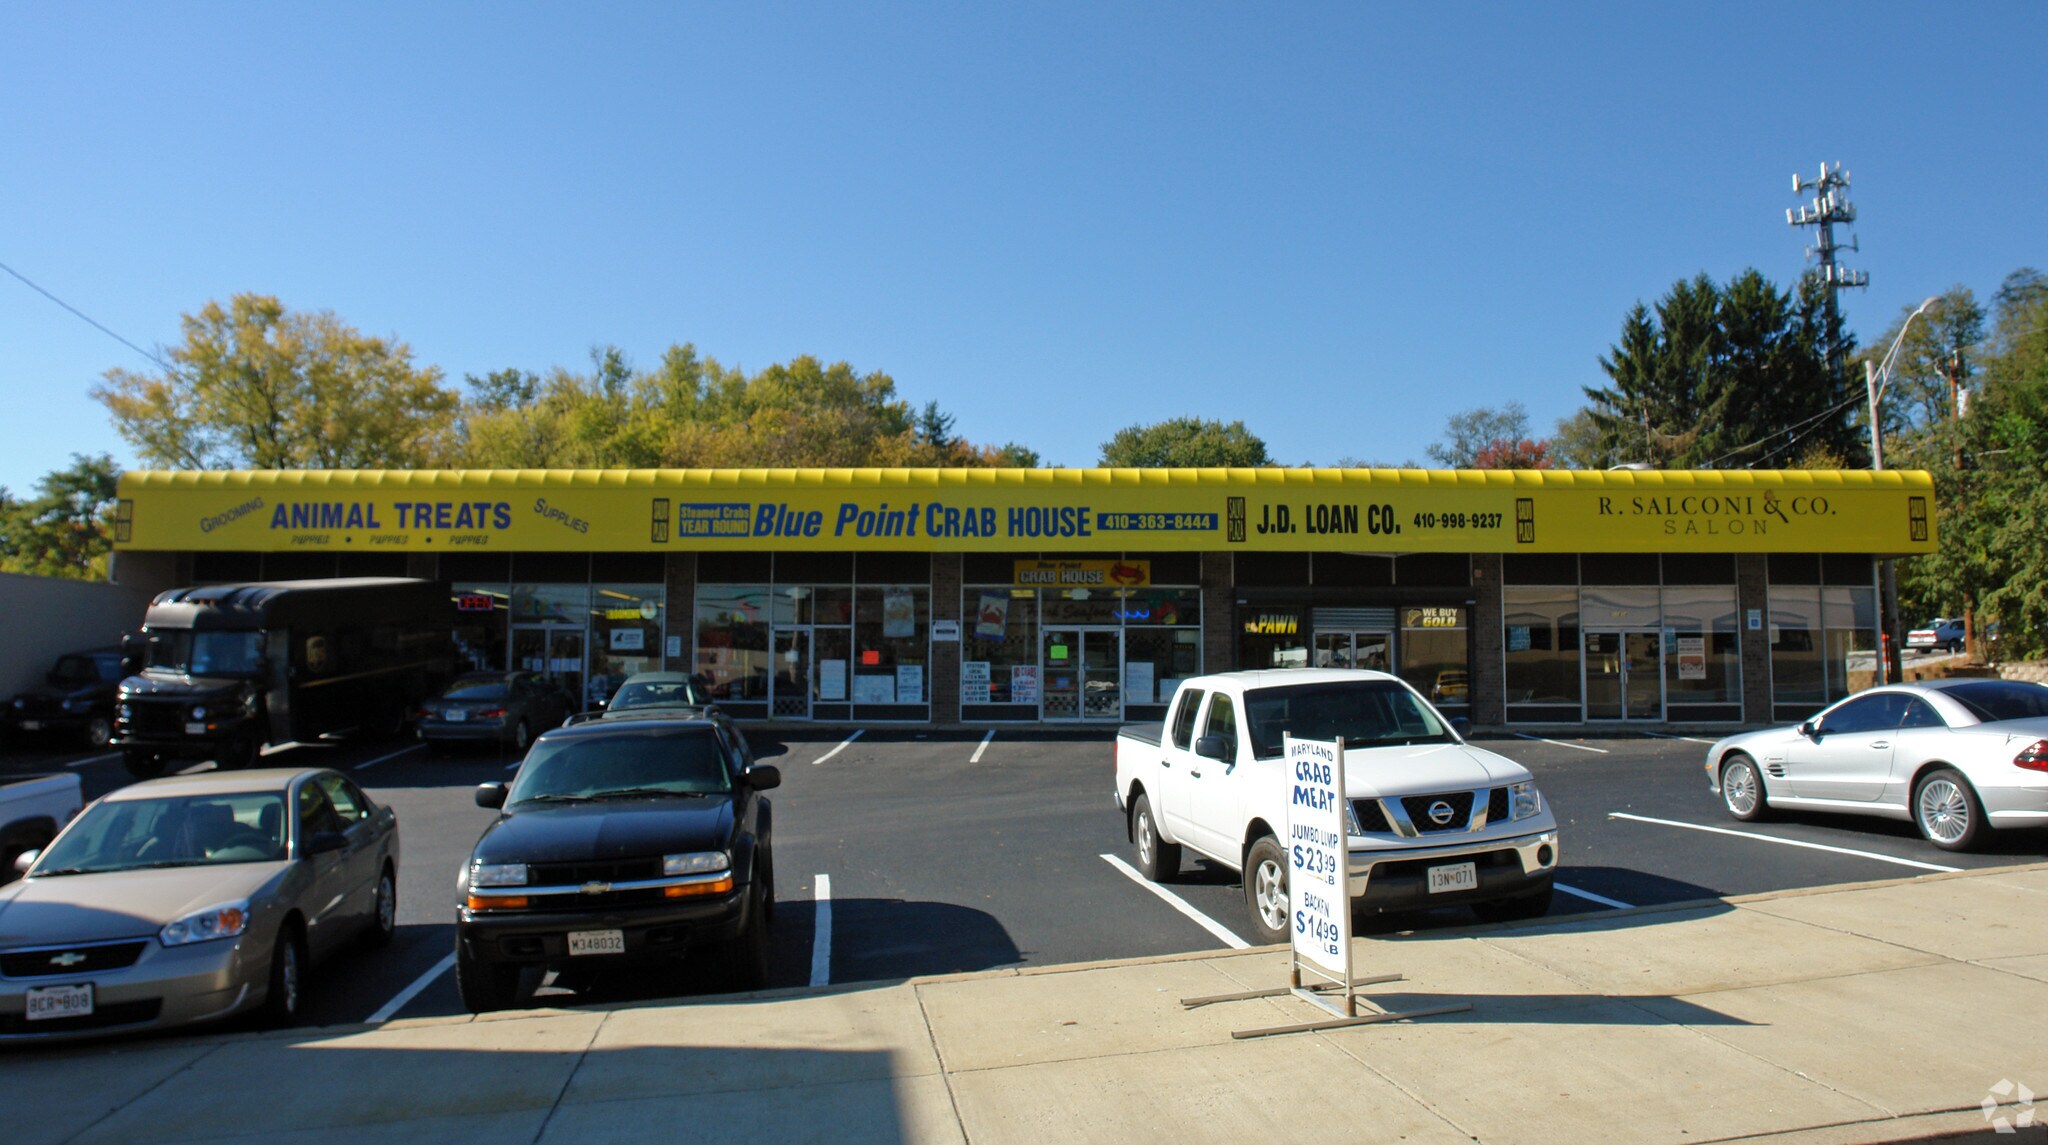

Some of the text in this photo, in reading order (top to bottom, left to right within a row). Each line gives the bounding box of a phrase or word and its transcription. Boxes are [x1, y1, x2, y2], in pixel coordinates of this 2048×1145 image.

[200, 496, 264, 534] GROOMING
[270, 502, 512, 530] ANIMAL TREATS
[533, 498, 589, 534] SUPPLIES
[681, 506, 750, 519] Steamed Crabs
[1598, 493, 1837, 523] R. SALCONI & CO.
[681, 519, 748, 534] YEAR ROUND
[753, 502, 1092, 537] Blue Point CRAB HOUSE
[1105, 515, 1211, 529] 410-363-8444
[1256, 504, 1401, 535] J.D. LOAN CO.
[1413, 513, 1502, 529] 410-998-9237
[1664, 519, 1768, 535] SALON
[1020, 570, 1104, 583] CRAB HOUSE
[460, 596, 491, 609] OPEN
[1423, 608, 1458, 617] WE BUY
[1258, 614, 1298, 634] PAWN
[1423, 616, 1457, 627] GOLD
[1291, 744, 1334, 762] MARYLAND
[1296, 761, 1332, 786] CRAB
[1292, 785, 1335, 814] MEAT
[1291, 824, 1320, 844] JUMBO
[1455, 870, 1473, 884] 071
[1323, 944, 1339, 955] LB
